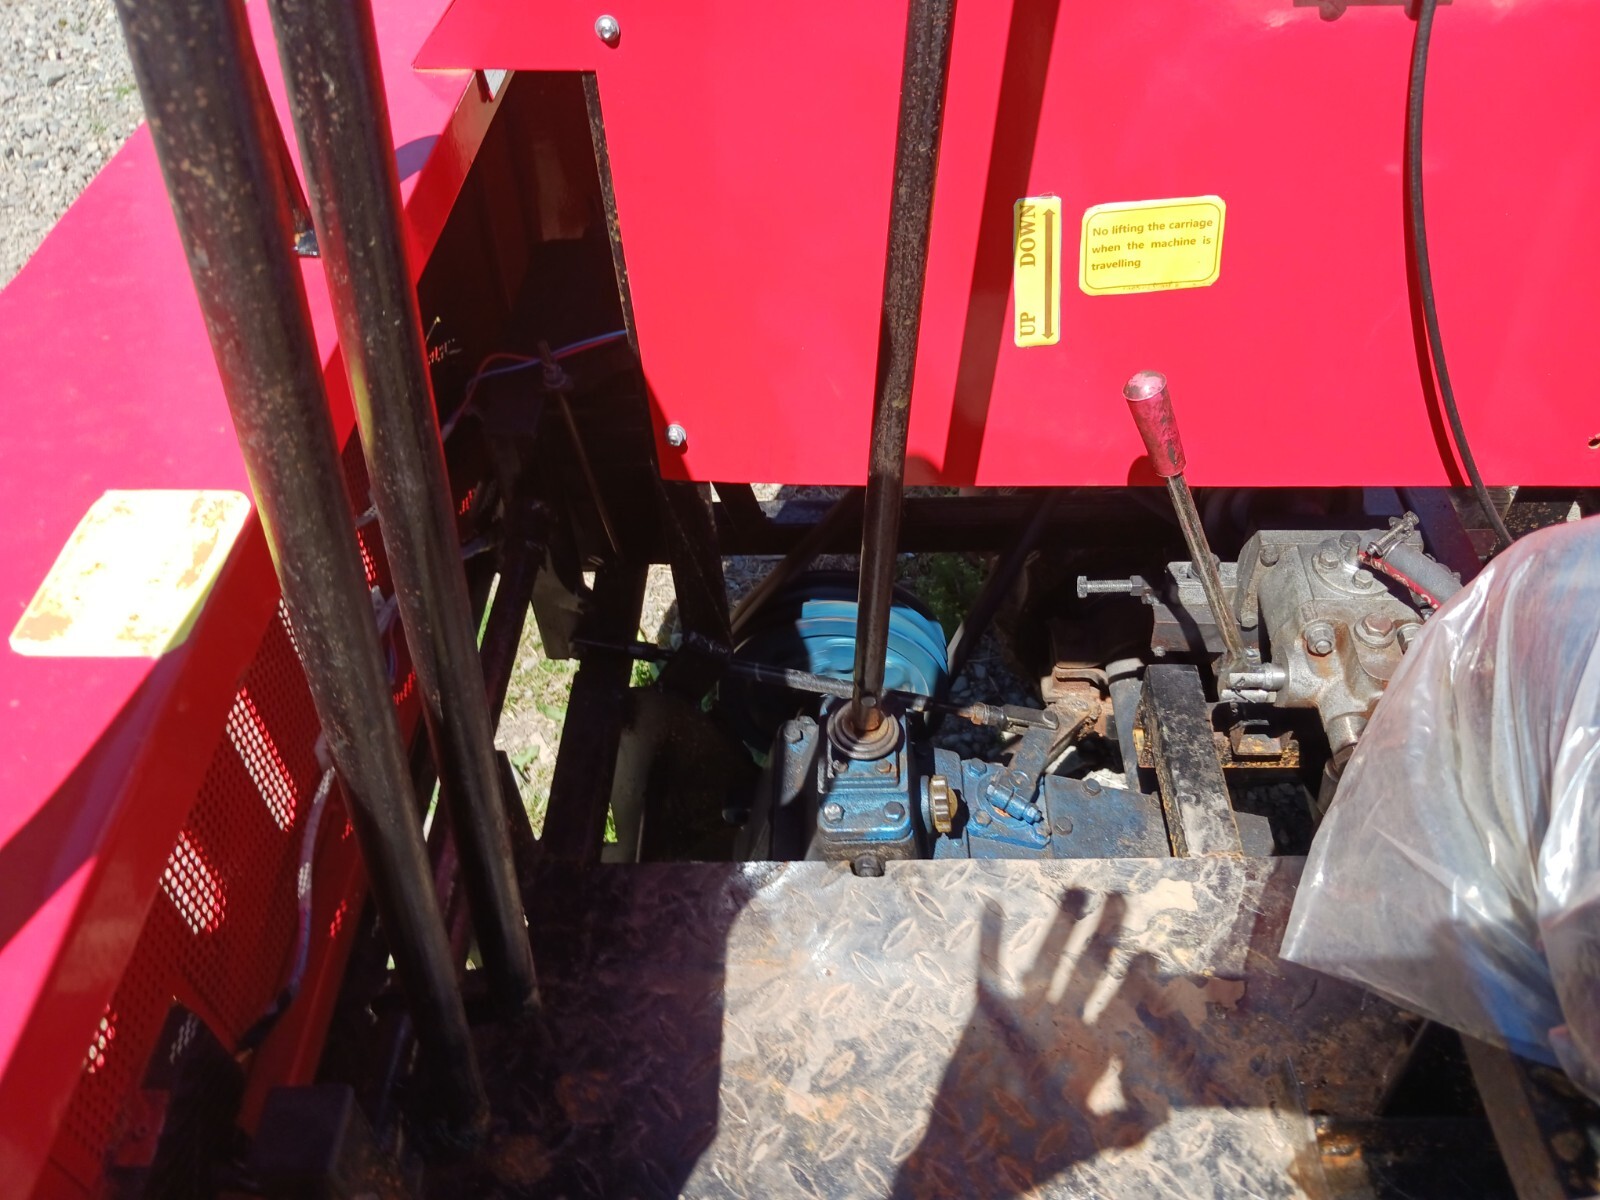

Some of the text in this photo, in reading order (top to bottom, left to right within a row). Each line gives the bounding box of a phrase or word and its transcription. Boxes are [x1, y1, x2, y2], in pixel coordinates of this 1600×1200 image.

[1020, 204, 1036, 267] DOWN
[1093, 219, 1213, 236] No lifting the carriage
[1092, 236, 1211, 254] when the machine is
[1091, 259, 1141, 271] travelling
[1020, 312, 1036, 337] UP
